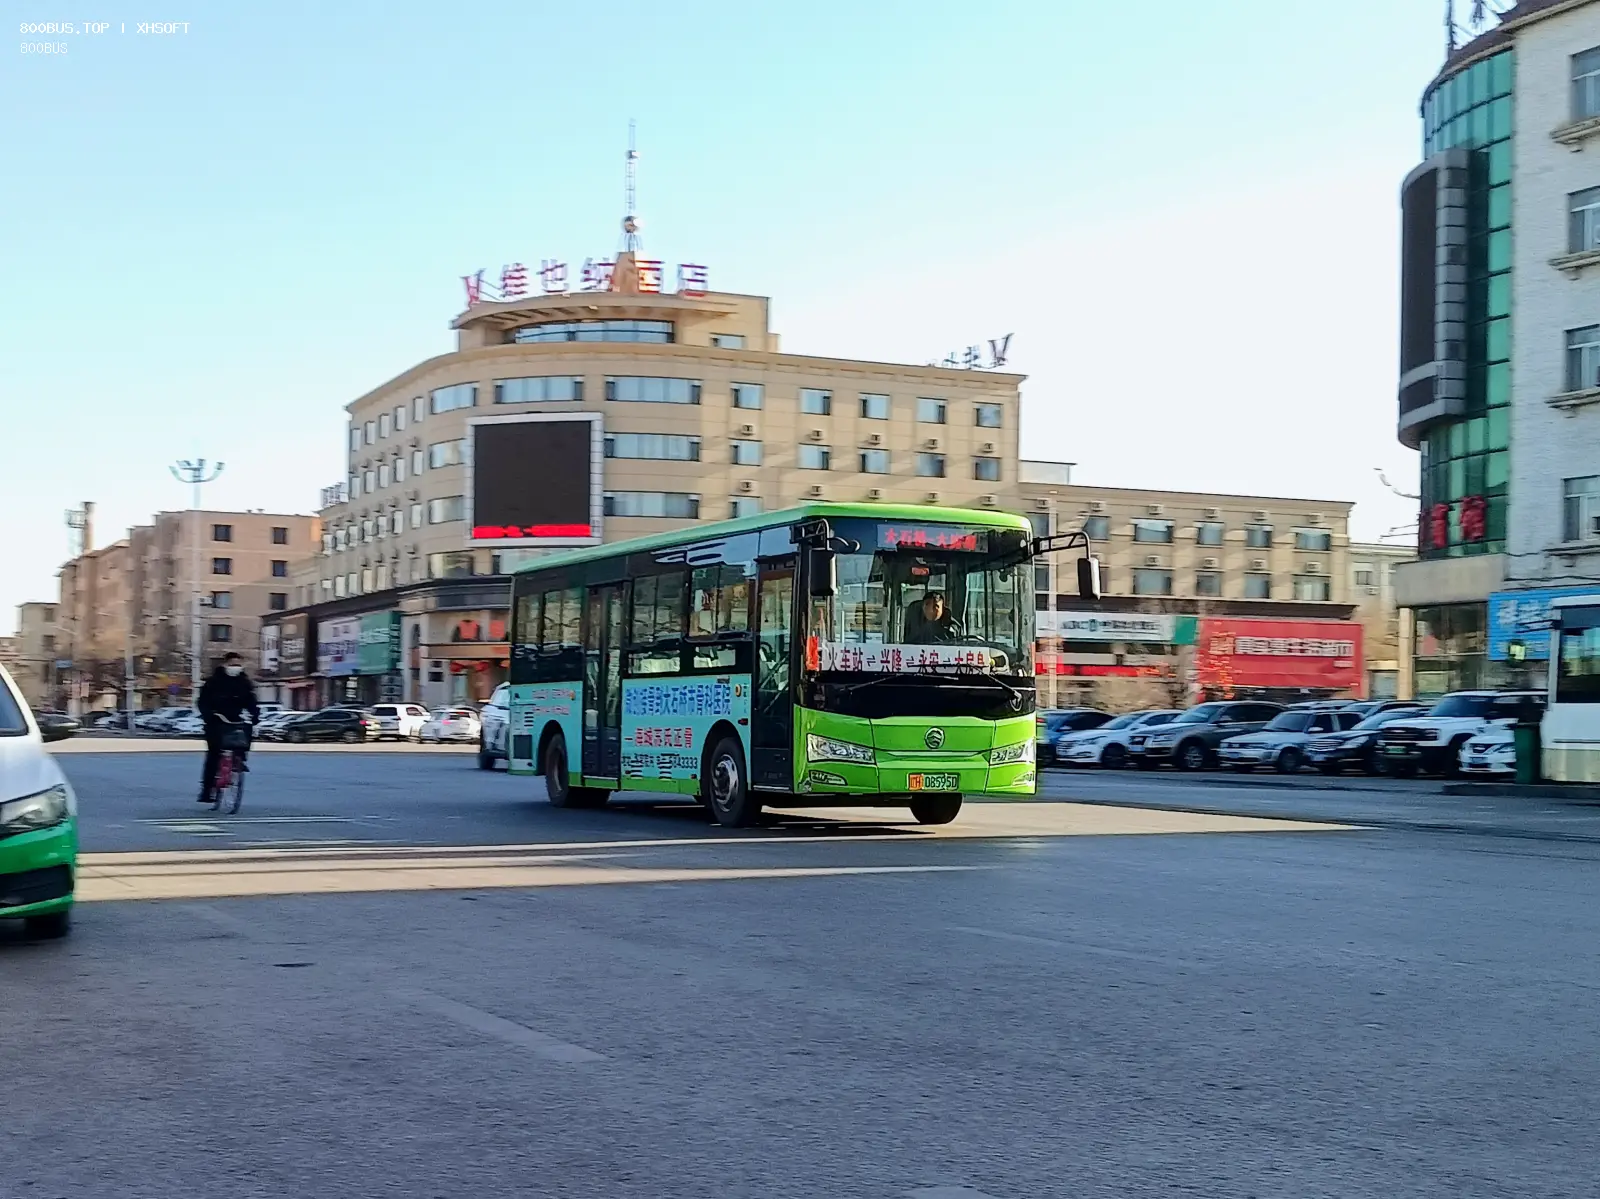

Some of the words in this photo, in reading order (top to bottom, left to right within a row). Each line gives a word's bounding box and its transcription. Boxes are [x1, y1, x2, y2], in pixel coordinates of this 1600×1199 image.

[828, 646, 863, 672] 火车站
[880, 648, 902, 673] 兴隆
